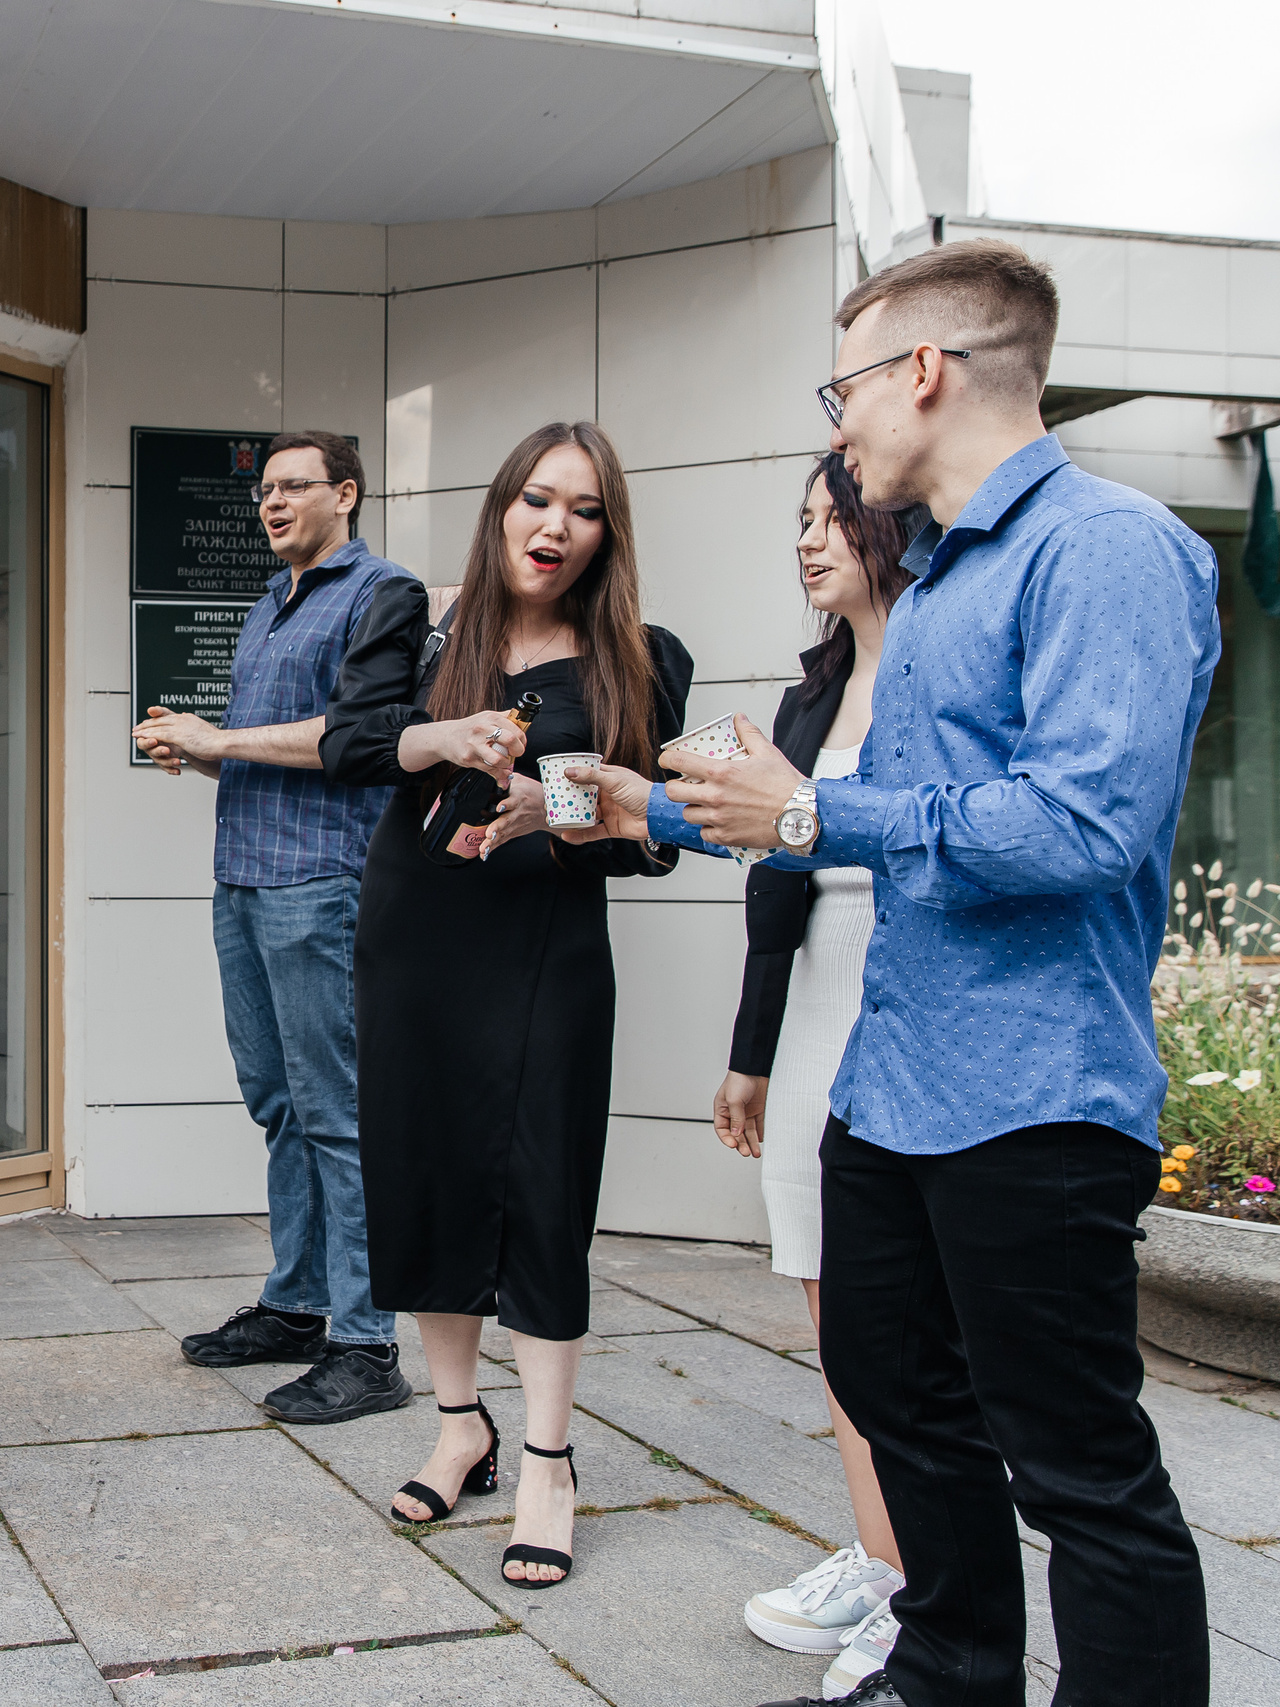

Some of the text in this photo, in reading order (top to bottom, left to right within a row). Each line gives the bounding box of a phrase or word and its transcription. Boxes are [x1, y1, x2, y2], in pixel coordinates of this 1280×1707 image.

[220, 504, 261, 518] ОТДЕ
[185, 519, 246, 534] ЗАПИСИ
[182, 535, 271, 550] ГРАЖДАНС
[177, 567, 260, 579] ВЫБОРГСКОГО
[194, 611, 234, 622] ПРИЕМ
[193, 649, 229, 657] ПЕРЕРЫВ
[187, 659, 232, 667] ВОСКРЕСЕН
[160, 694, 232, 705] НАЧАЛЬНИК
